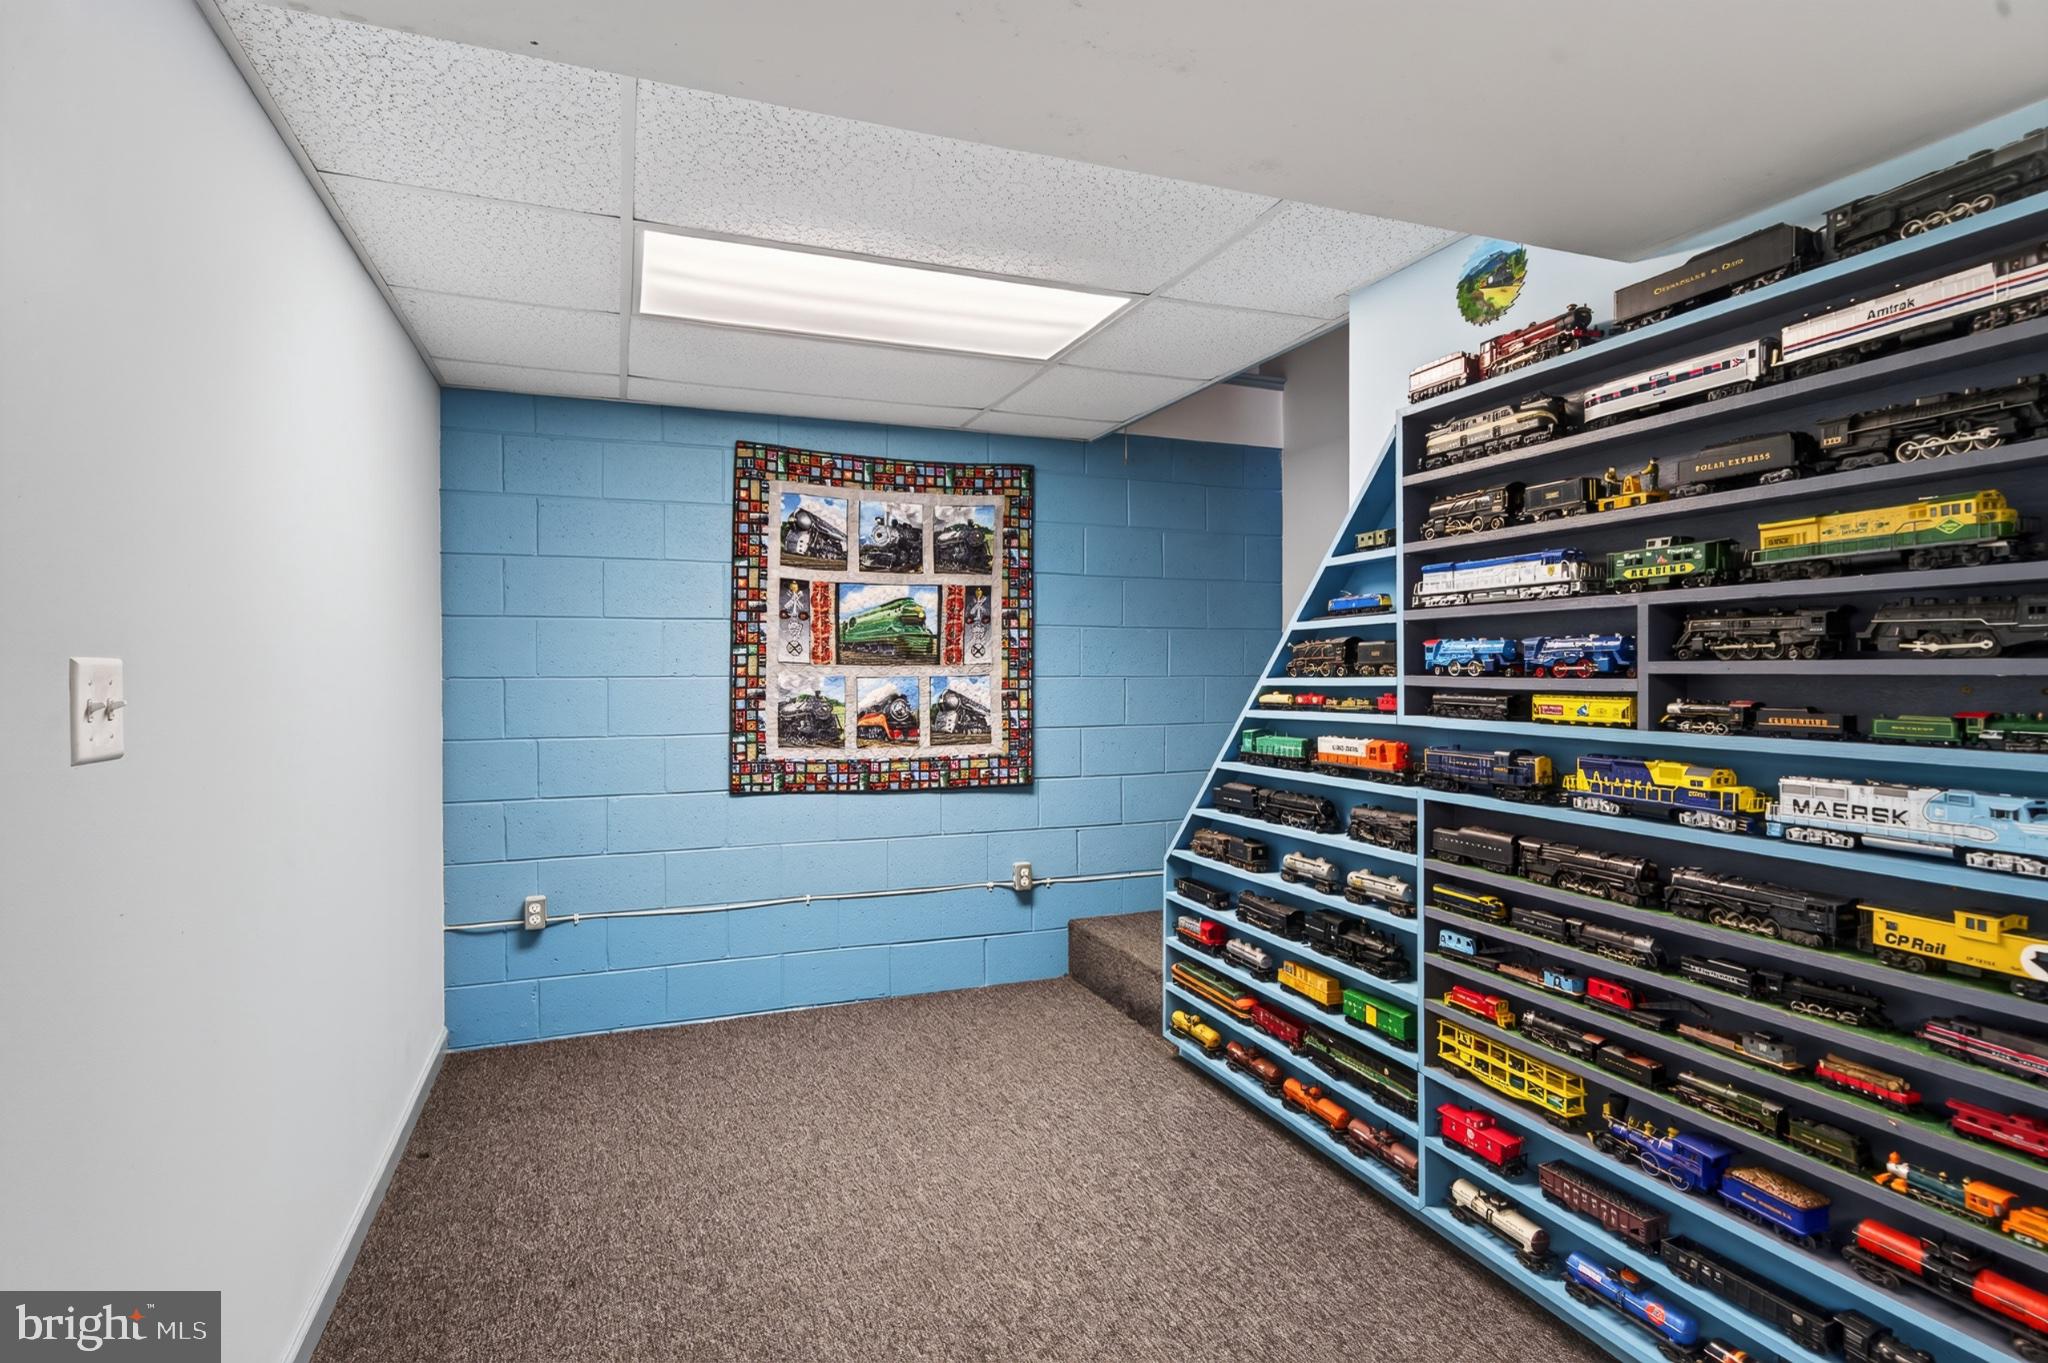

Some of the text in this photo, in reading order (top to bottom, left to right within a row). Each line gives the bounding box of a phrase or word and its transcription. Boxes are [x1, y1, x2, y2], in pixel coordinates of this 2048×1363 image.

[1866, 298, 1916, 321] Amtrak
[1695, 452, 1771, 473] POLAR EXPRESS
[1593, 770, 1653, 791] ALASKA
[1792, 799, 1908, 826] MAERSK
[1885, 932, 1947, 956] CP Rail
